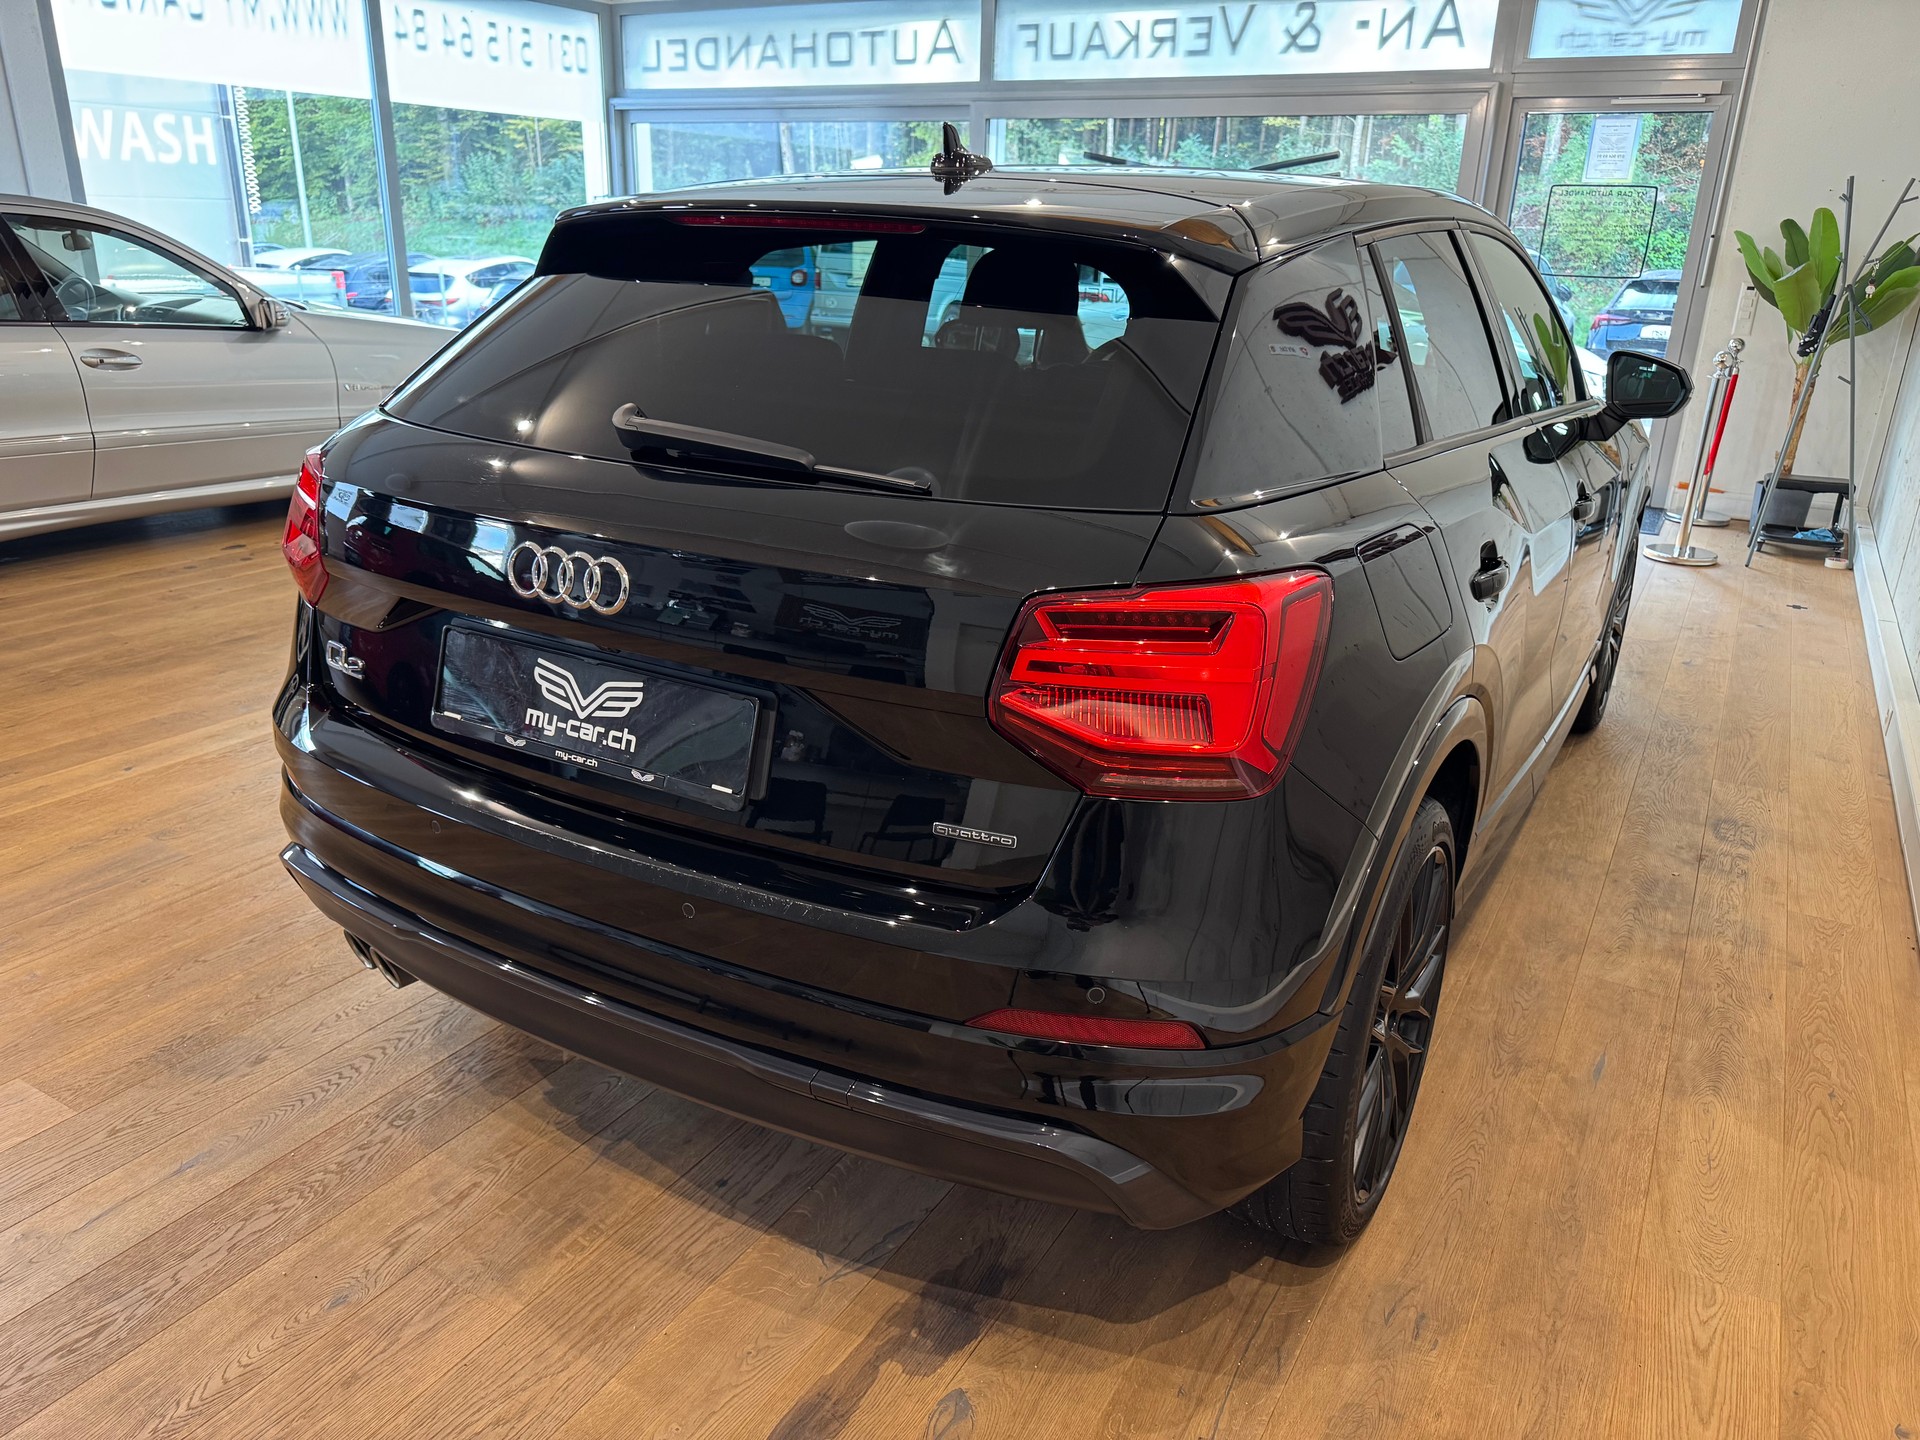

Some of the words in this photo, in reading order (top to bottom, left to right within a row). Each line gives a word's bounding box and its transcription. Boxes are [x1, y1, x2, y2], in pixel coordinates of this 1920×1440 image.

[72, 107, 217, 166] WASH
[325, 640, 366, 680] Q2
[525, 707, 637, 753] my-car.ch
[555, 749, 598, 767] my-car.ch
[936, 823, 1013, 845] quattro
